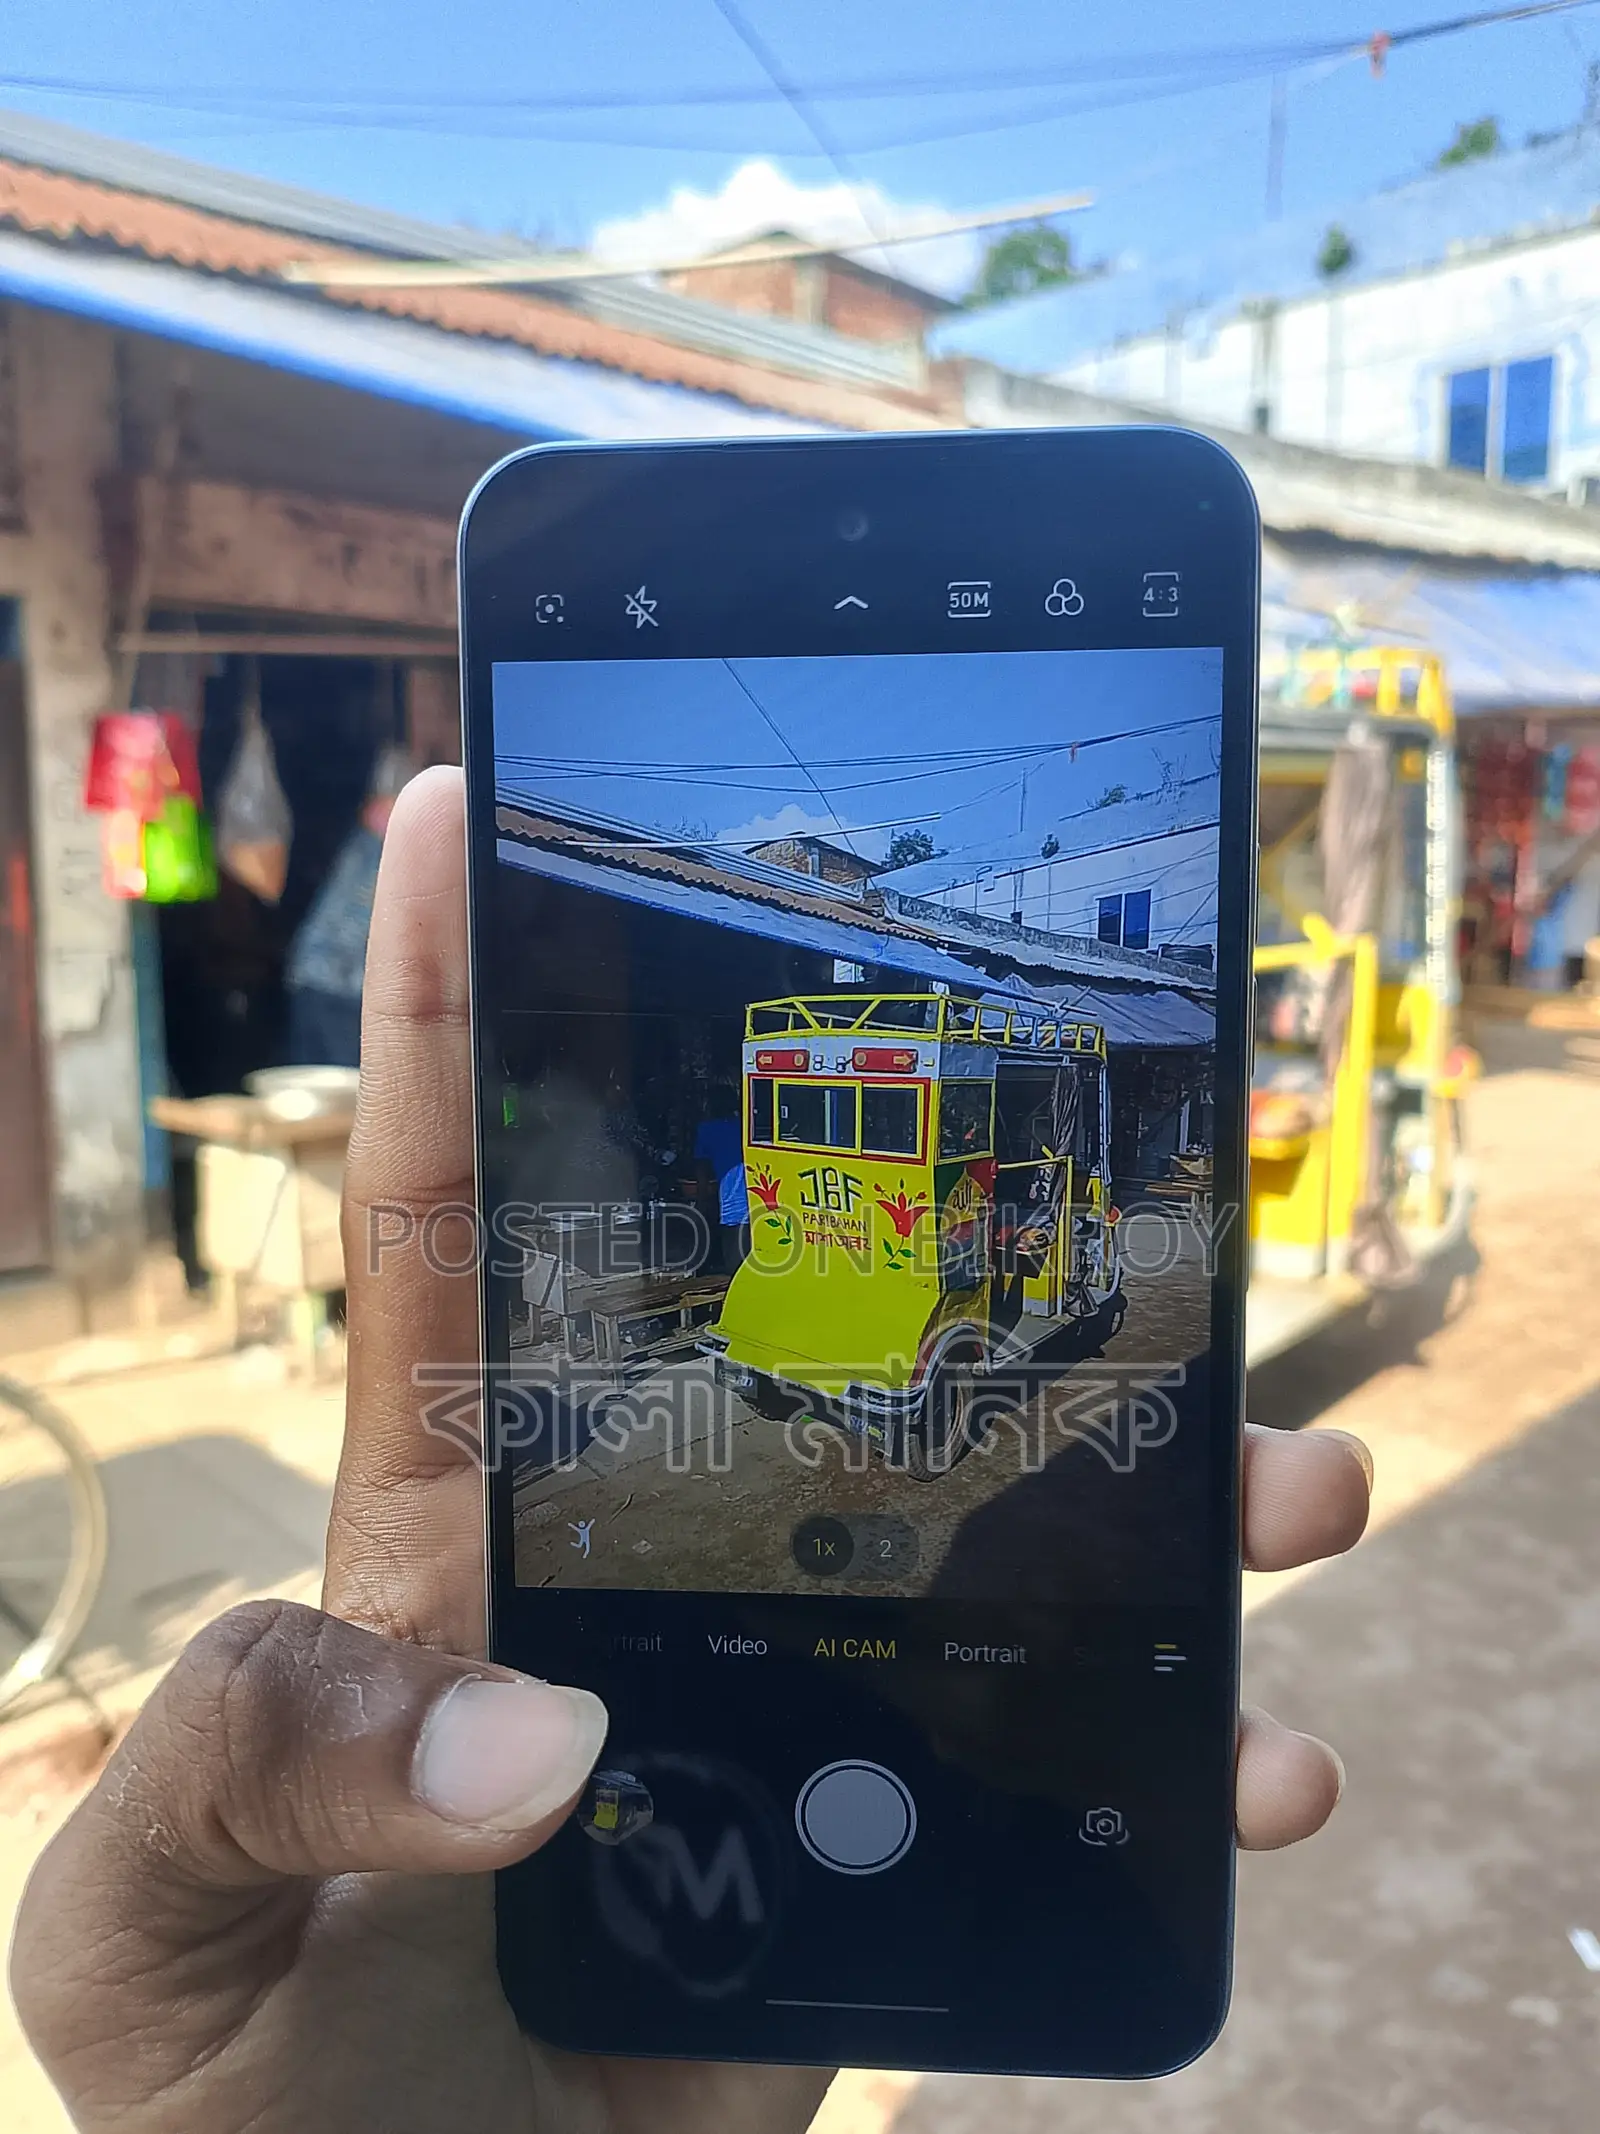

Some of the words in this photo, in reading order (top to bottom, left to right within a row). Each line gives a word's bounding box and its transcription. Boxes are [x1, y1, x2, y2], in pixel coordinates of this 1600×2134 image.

[949, 591, 989, 608] 50M
[798, 1165, 864, 1214] JBF
[802, 1212, 867, 1232] PARIBAHAN
[813, 1537, 836, 1556] 1x
[879, 1539, 893, 1558] 2
[707, 1635, 768, 1655] Video
[814, 1638, 836, 1657] AI
[843, 1639, 897, 1659] CAM
[943, 1642, 1028, 1664] Portrait
